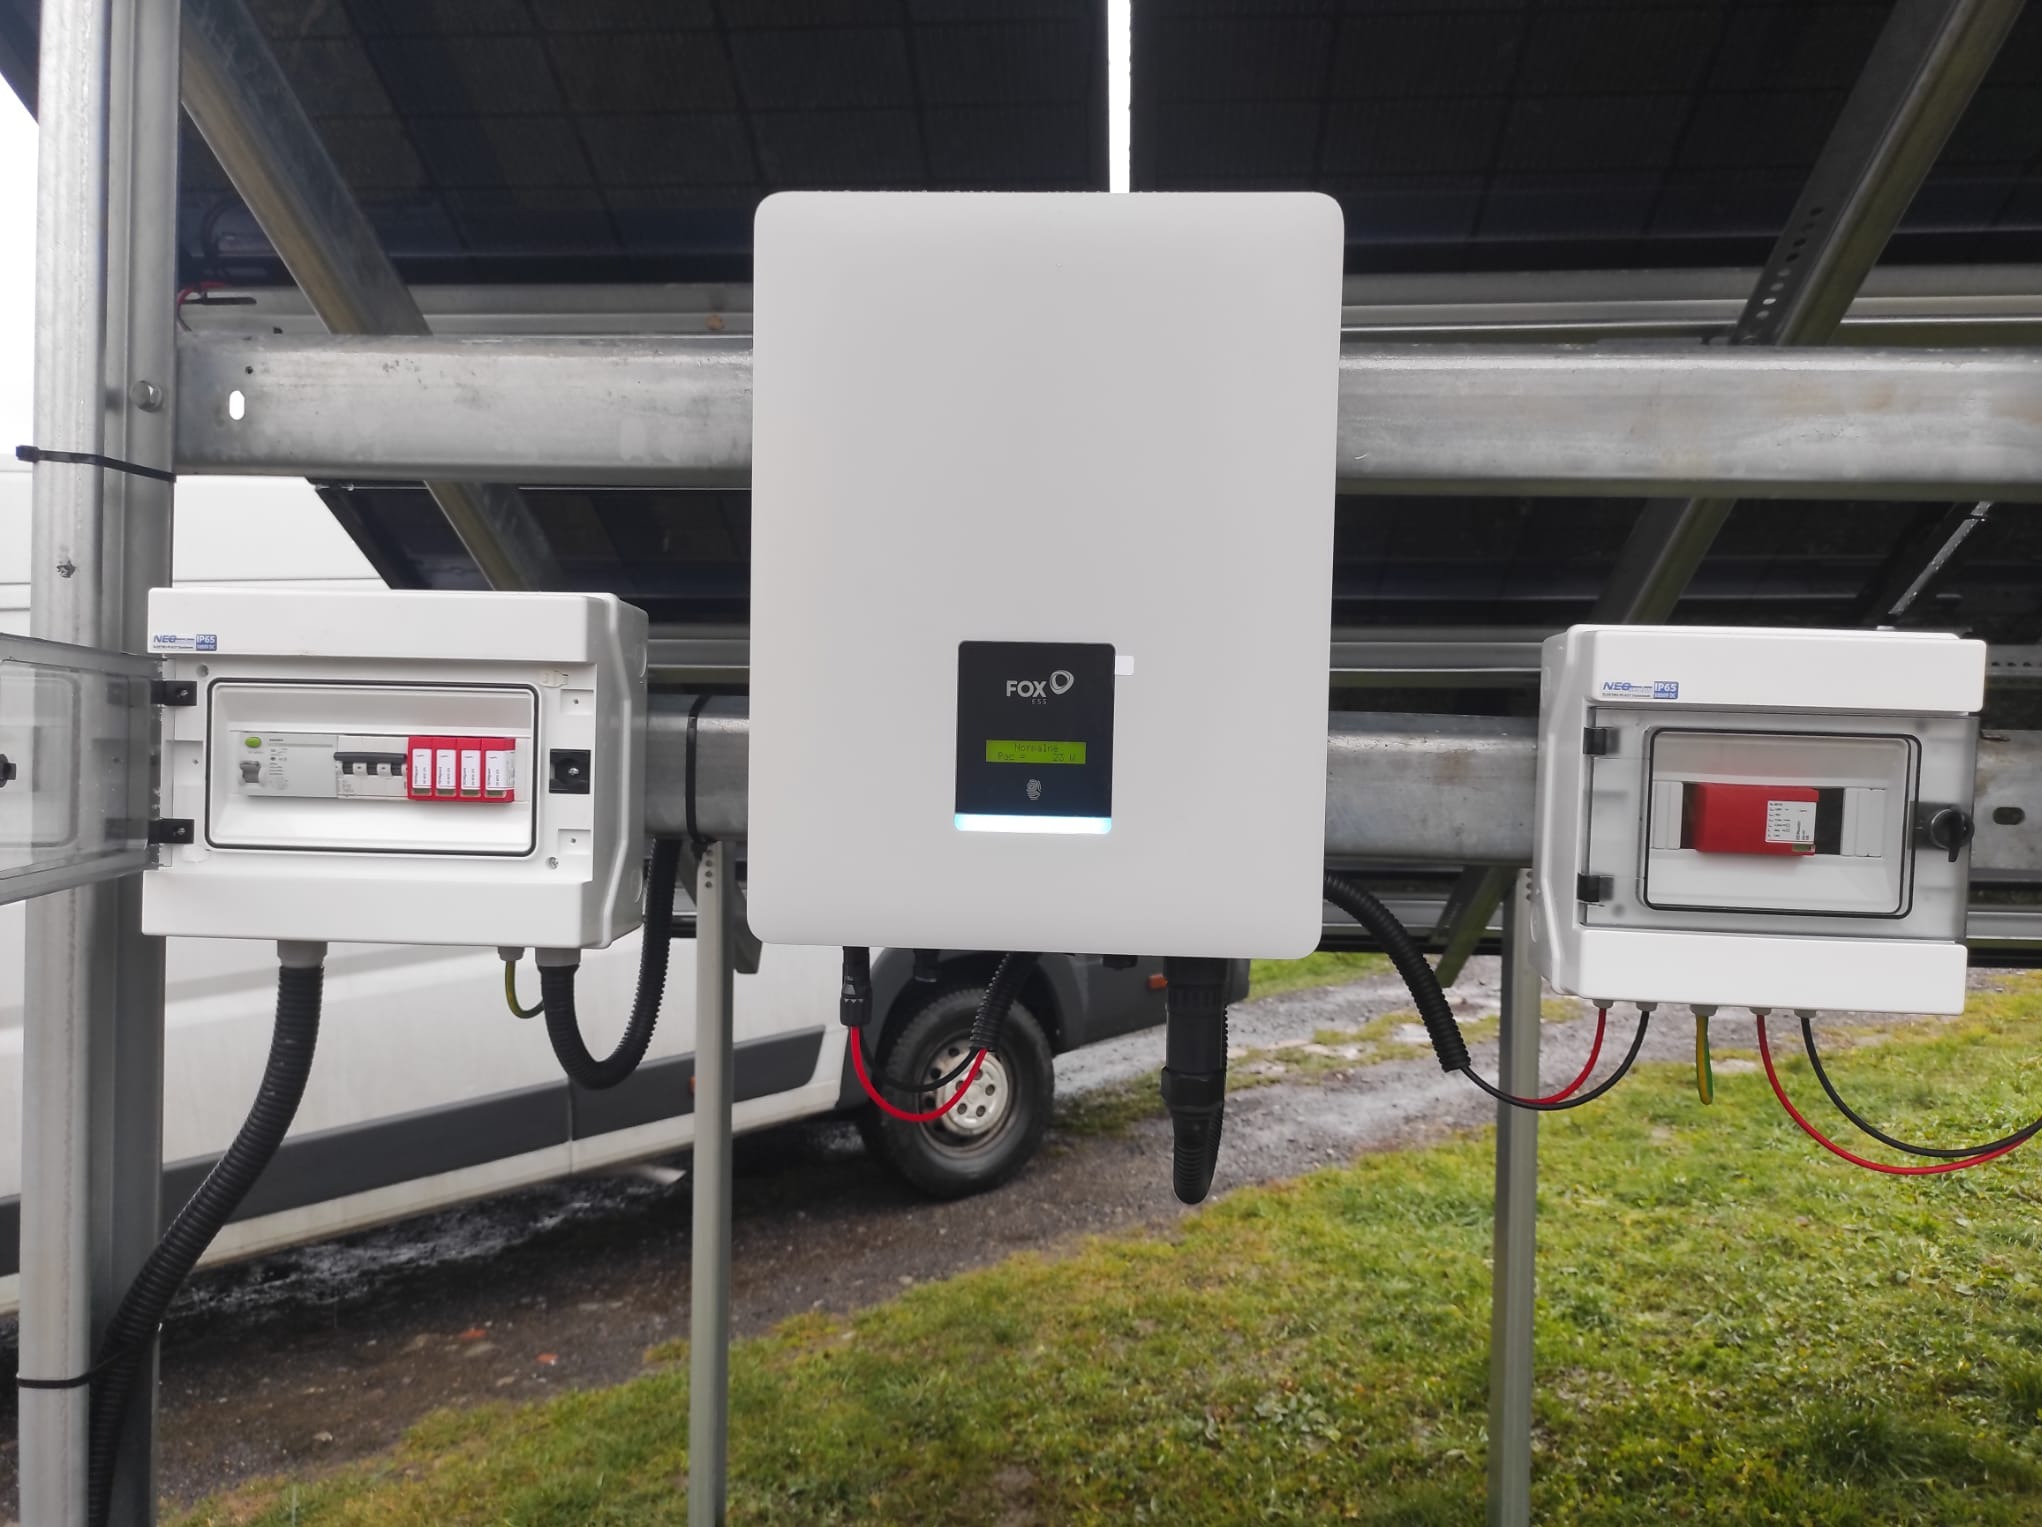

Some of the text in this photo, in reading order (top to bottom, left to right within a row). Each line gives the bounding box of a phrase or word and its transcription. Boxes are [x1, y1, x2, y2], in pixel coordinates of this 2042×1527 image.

[196, 635, 216, 644] IP65
[1006, 680, 1047, 698] FOX
[1602, 681, 1632, 691] NEO
[1654, 682, 1677, 692] IP65
